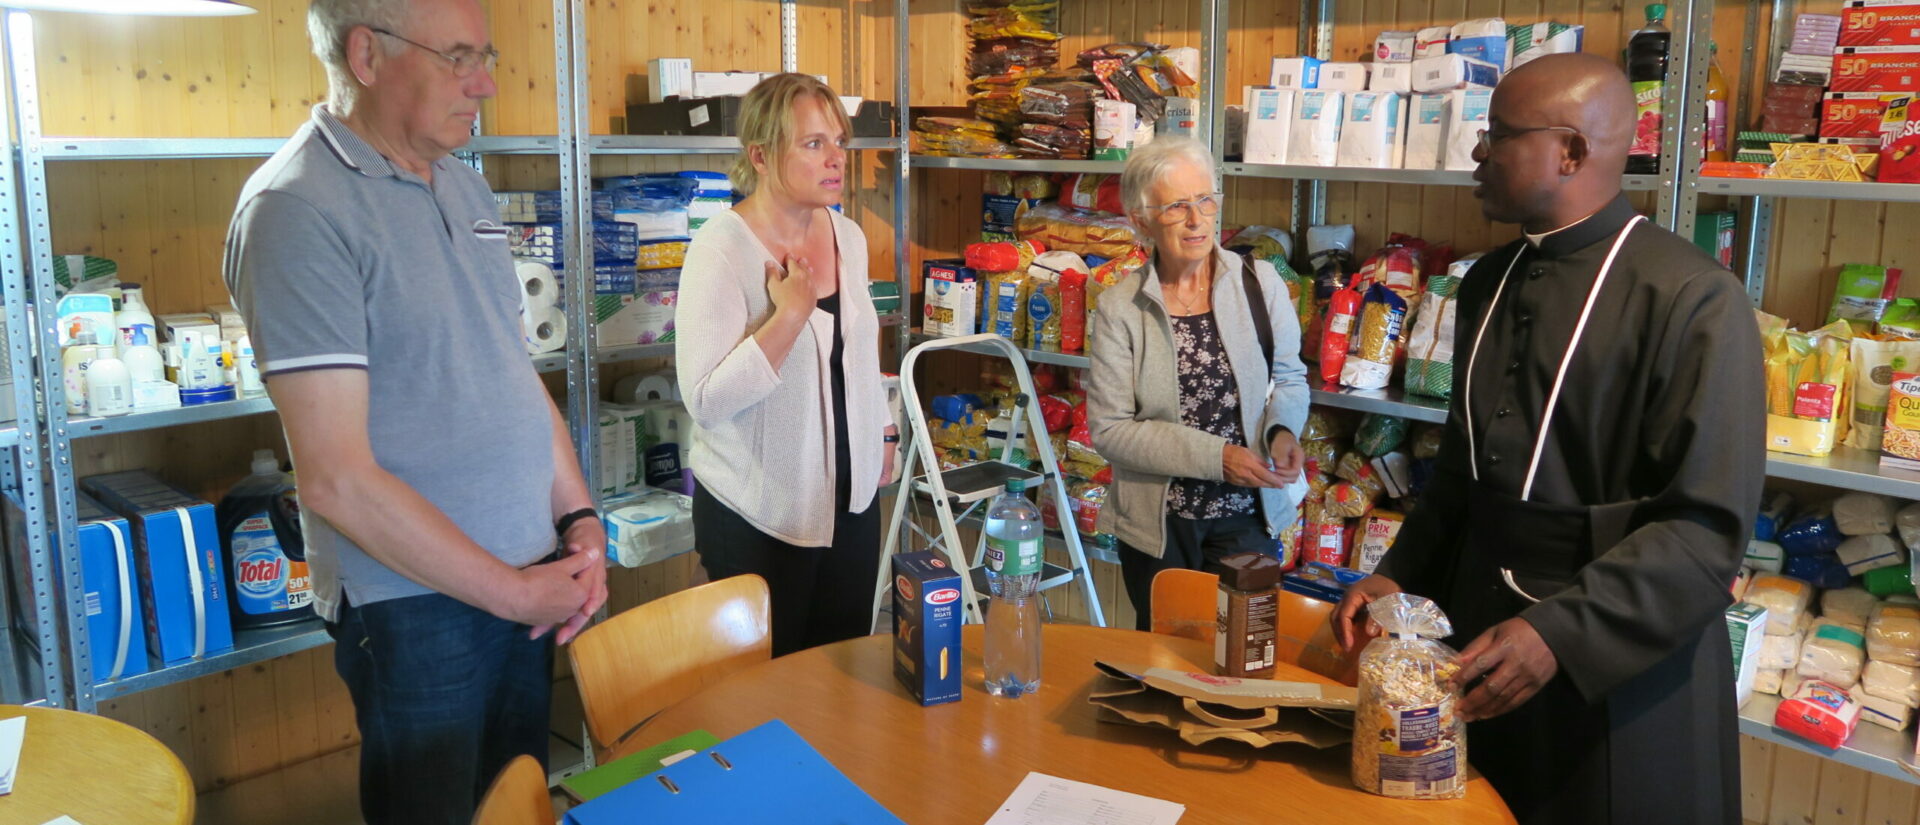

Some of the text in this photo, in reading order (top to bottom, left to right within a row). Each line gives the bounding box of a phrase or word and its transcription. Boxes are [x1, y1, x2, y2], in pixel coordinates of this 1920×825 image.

[1848, 12, 1876, 29] 50
[1839, 59, 1868, 76] 50
[1828, 104, 1856, 121] 50
[931, 269, 954, 281] AGNESI
[1363, 543, 1383, 552] Penne
[240, 557, 283, 584] Total
[933, 591, 958, 601] Barilla
[934, 605, 951, 613] PENNE
